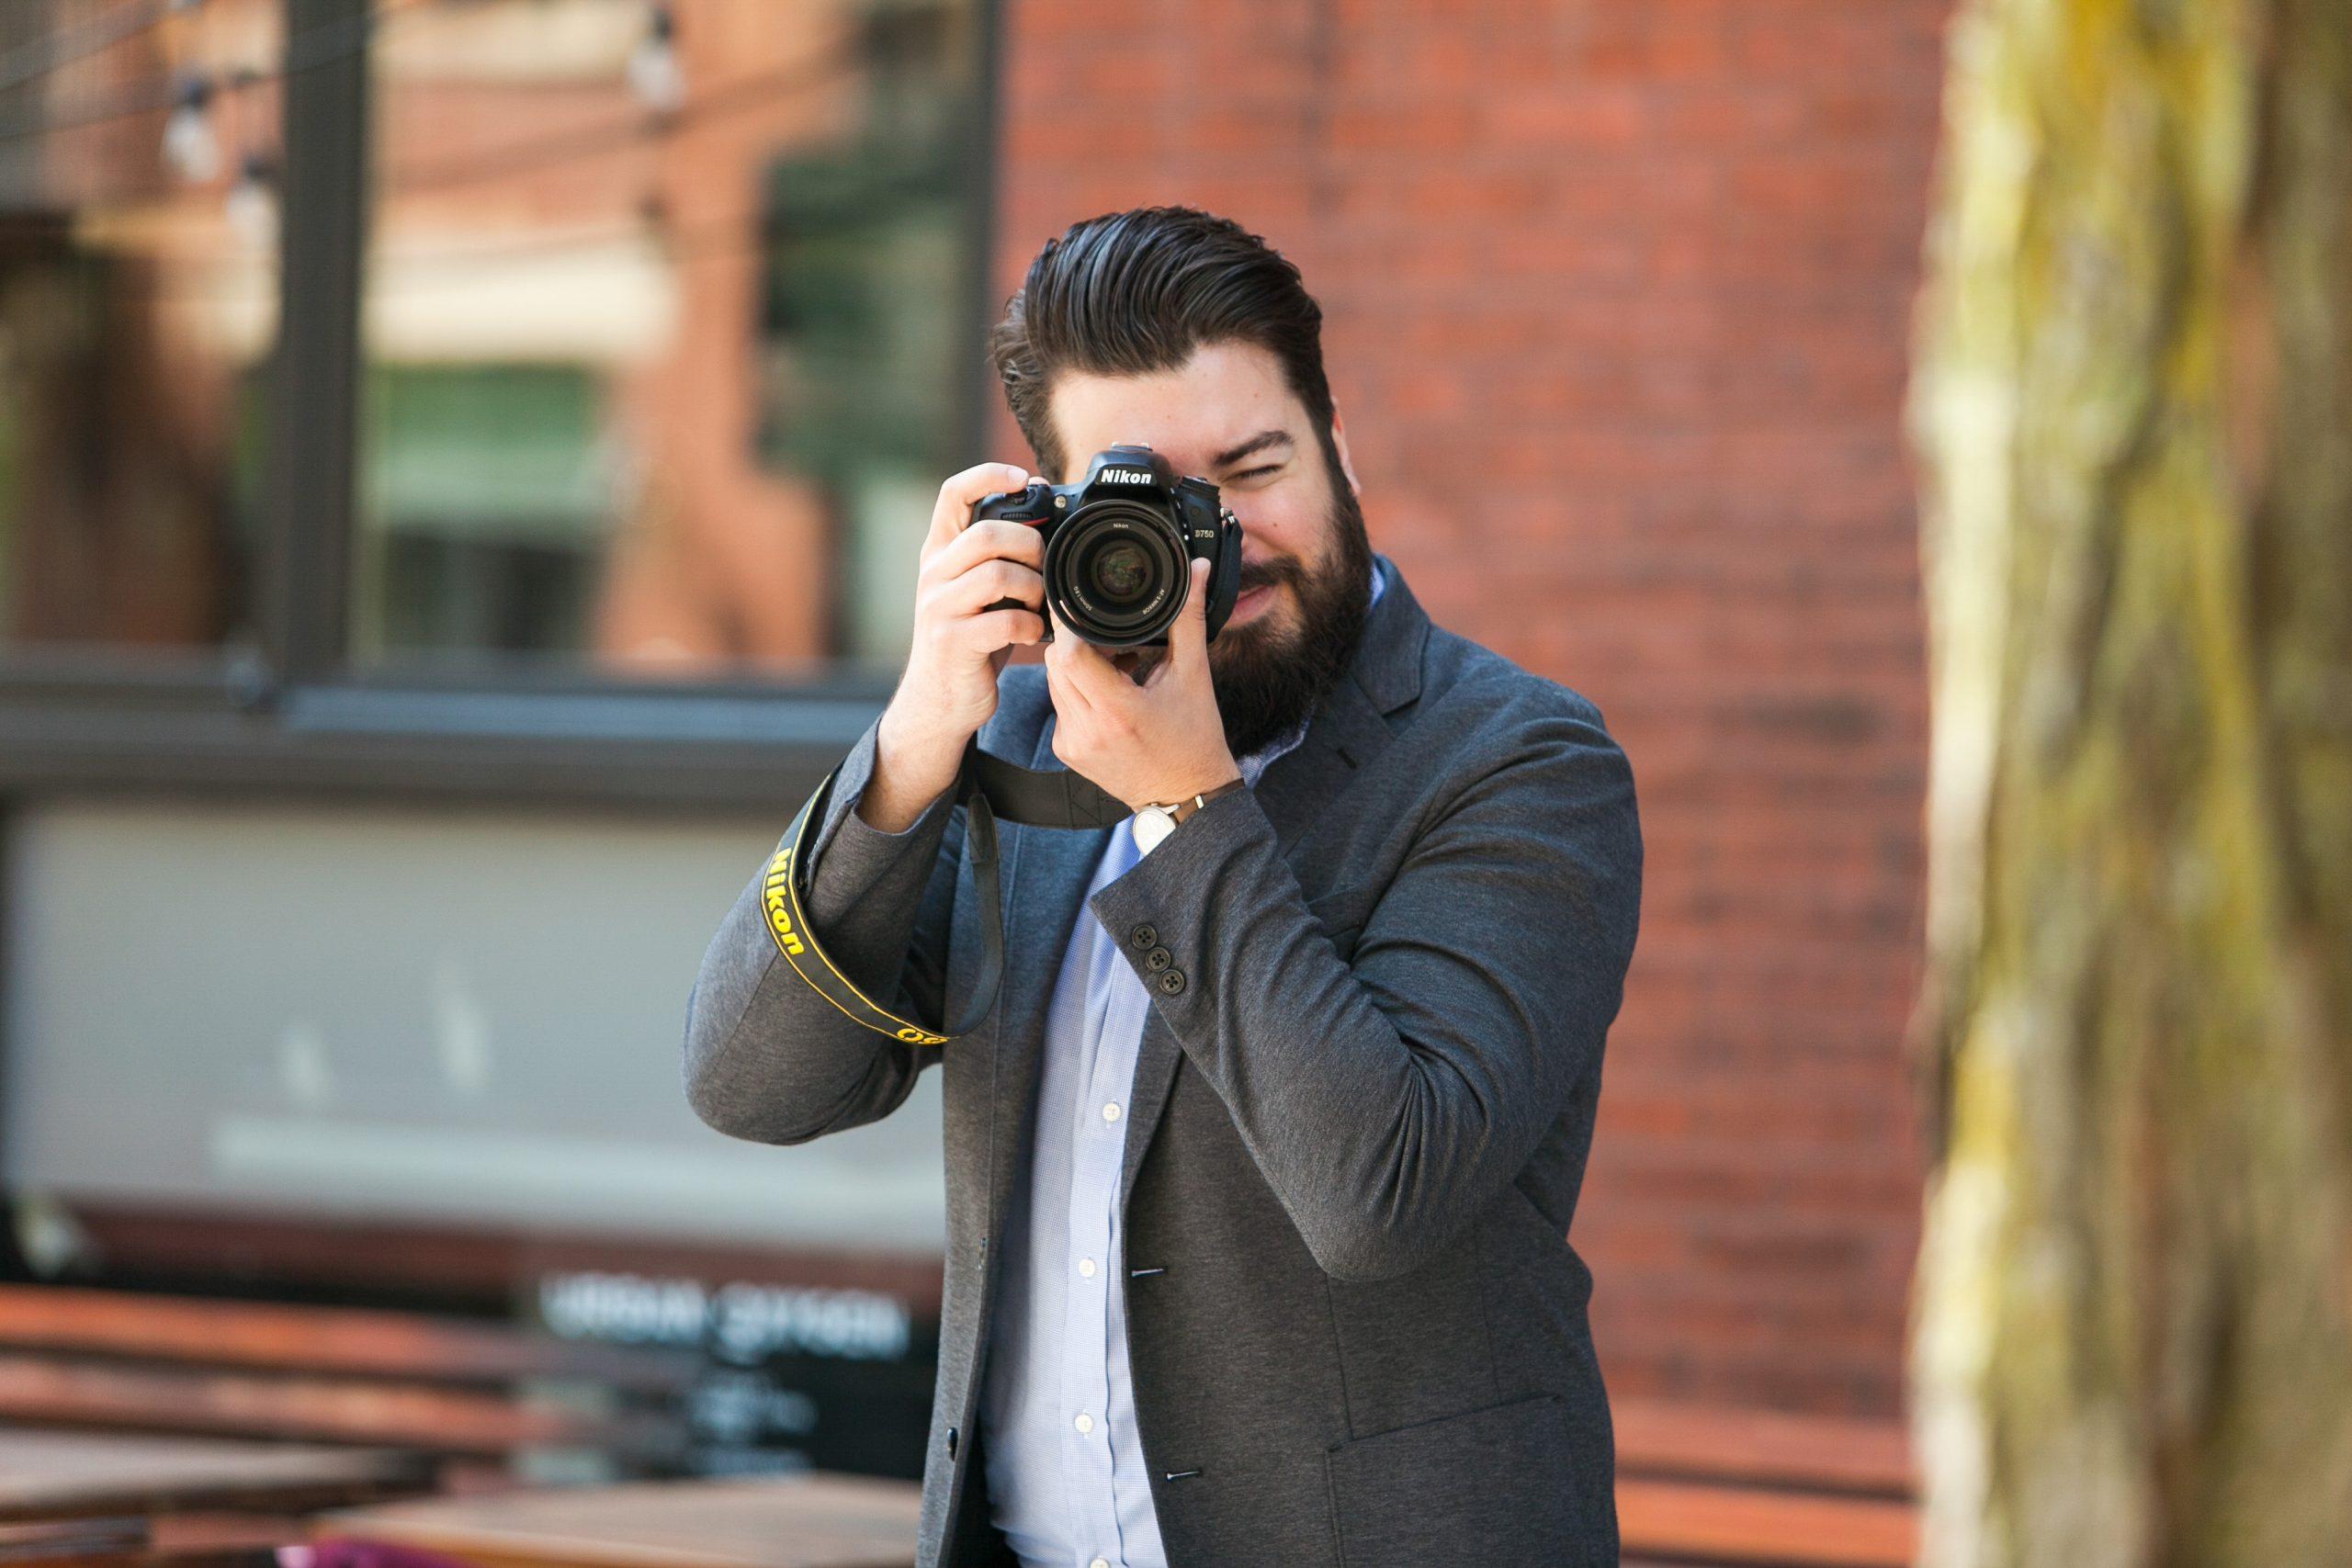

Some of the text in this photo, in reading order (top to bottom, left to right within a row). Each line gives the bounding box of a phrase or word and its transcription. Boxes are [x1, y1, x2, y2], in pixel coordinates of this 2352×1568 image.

[1101, 468, 1152, 484] Nikon
[1194, 529, 1215, 538] D750
[768, 847, 805, 955] Nikon
